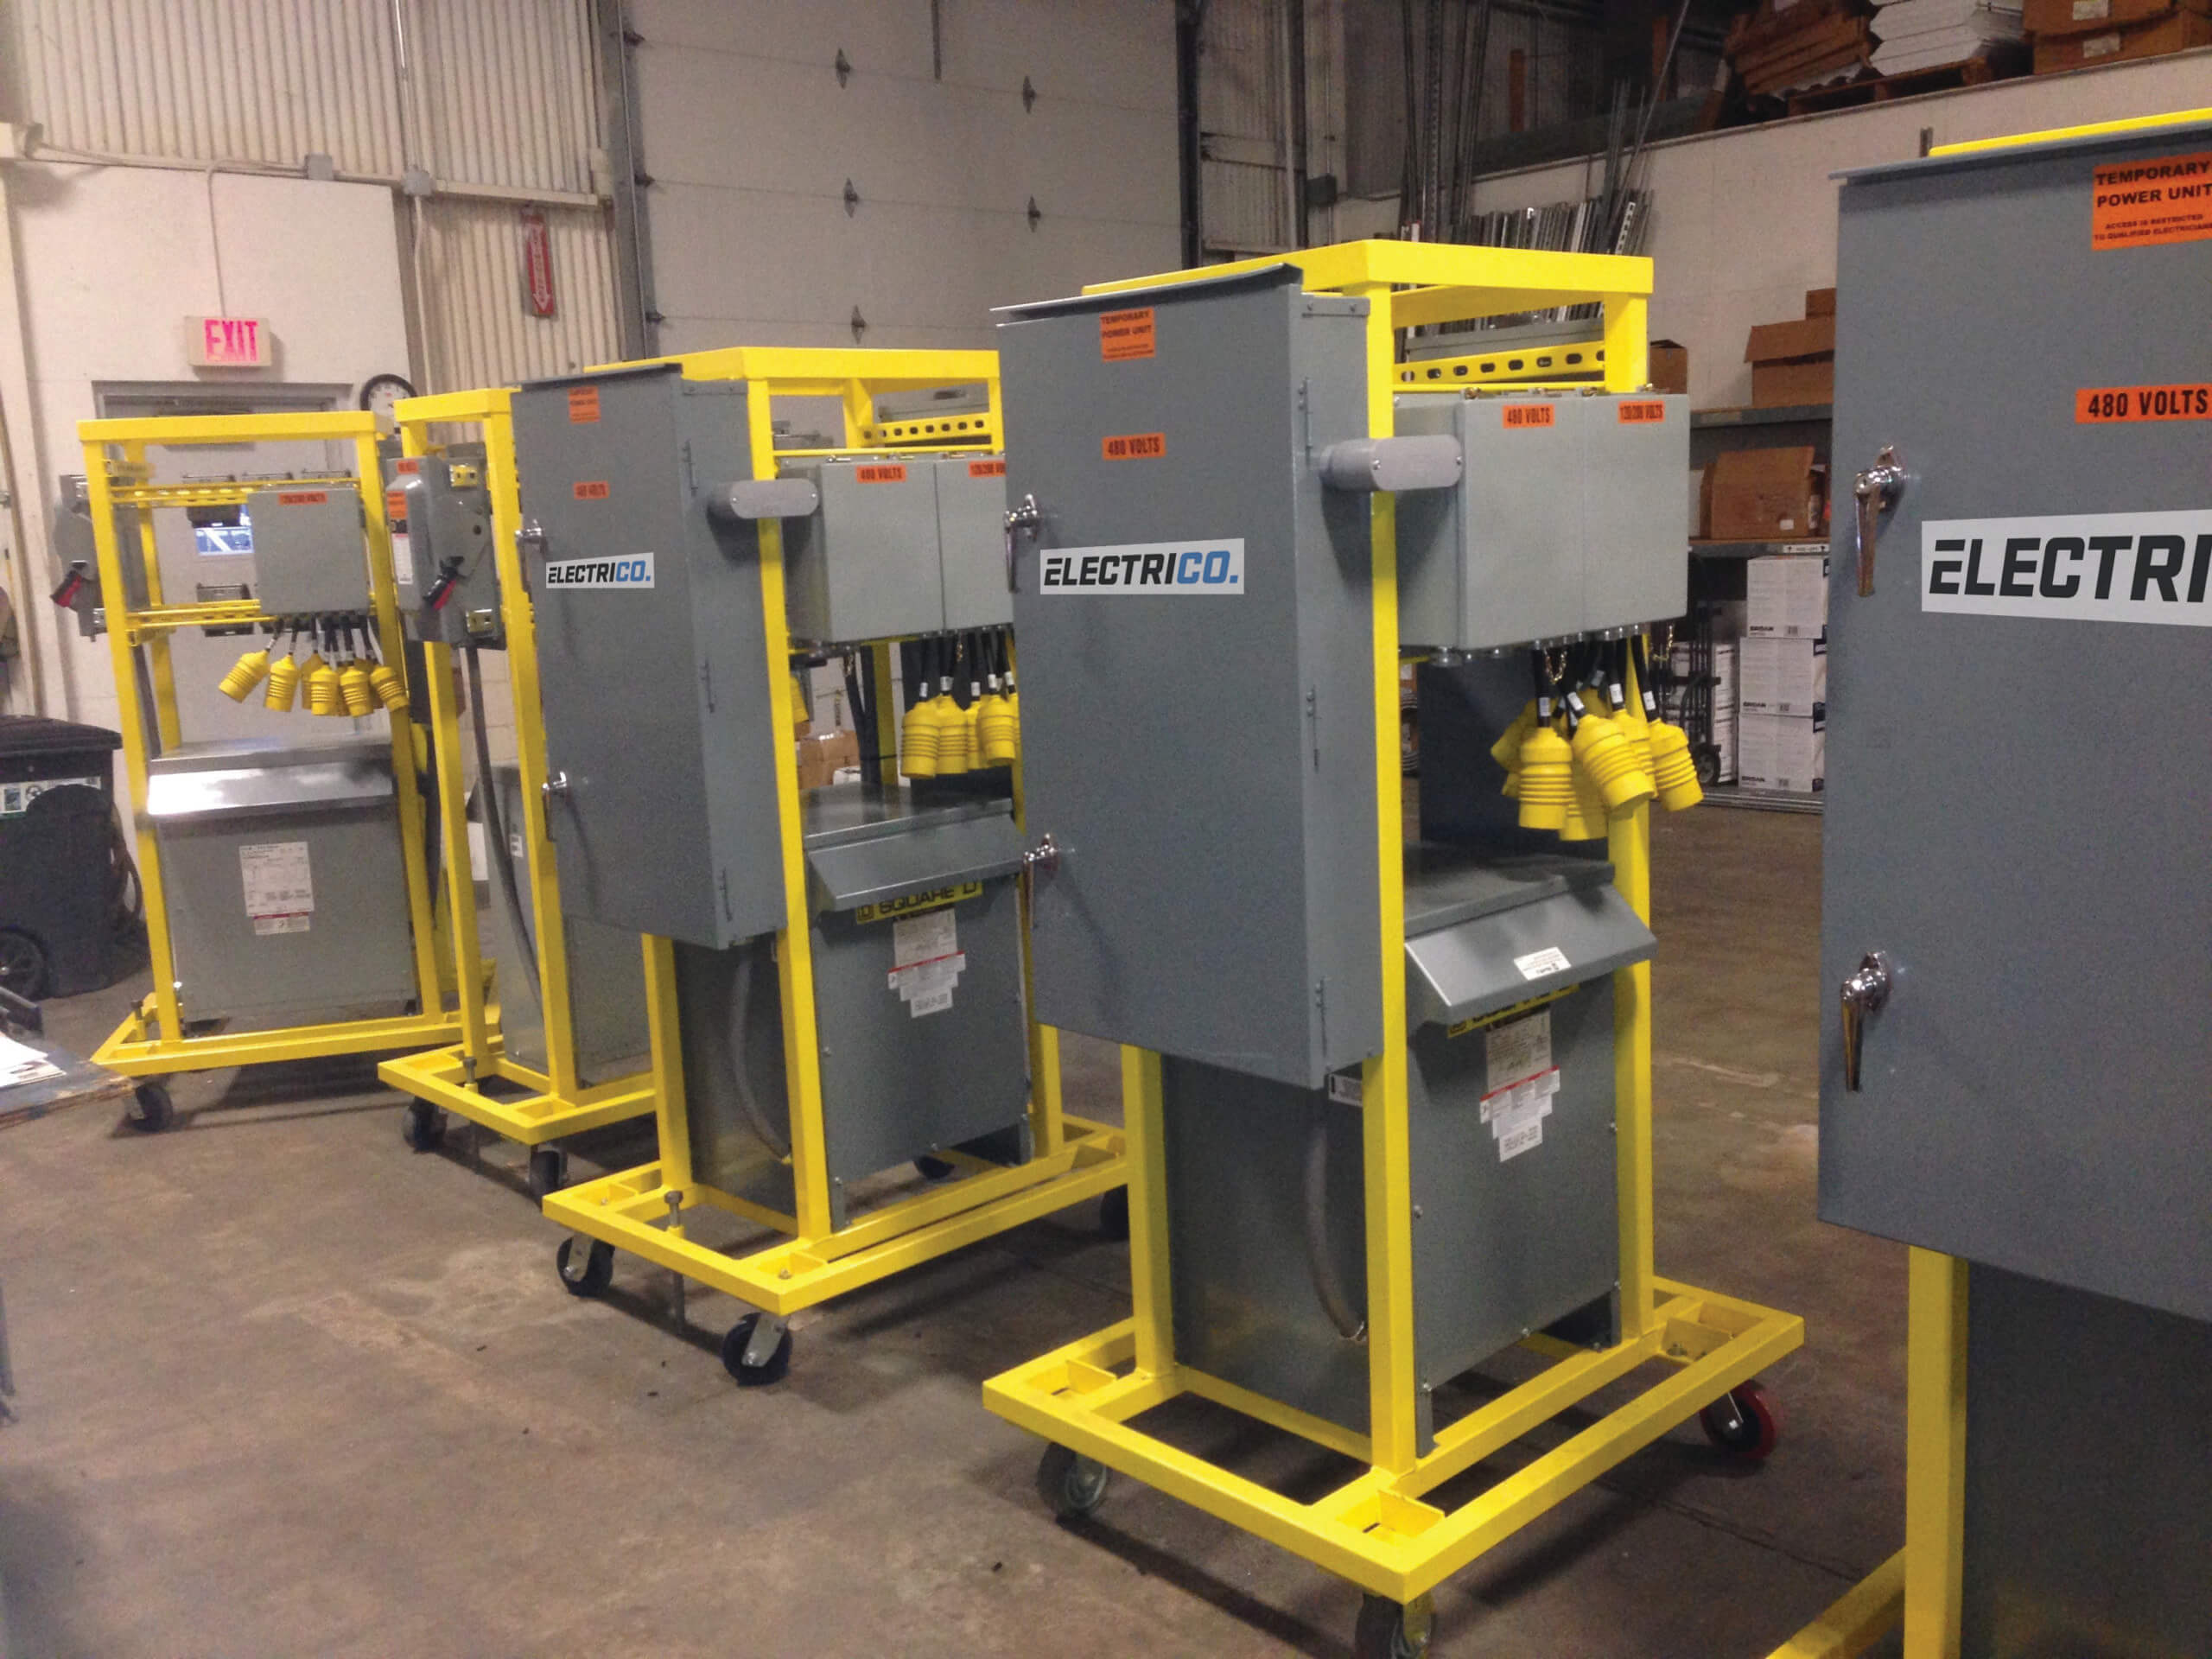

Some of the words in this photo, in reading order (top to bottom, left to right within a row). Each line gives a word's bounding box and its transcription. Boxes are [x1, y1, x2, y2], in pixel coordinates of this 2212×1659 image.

[2095, 160, 2210, 186] TEMPORARY
[2097, 189, 2162, 207] POWER
[2168, 183, 2212, 200] UNIT
[204, 319, 257, 362] EXIT
[1525, 407, 1550, 423] VOLTS
[2088, 392, 2128, 417] 480
[2139, 389, 2208, 416] VOLTS
[1108, 439, 1126, 456] 480
[1128, 436, 1160, 454] VOLTS
[877, 467, 903, 480] VOLTS
[548, 560, 651, 584] ELECTRICO.
[1044, 550, 1238, 586] ELECTRICO.
